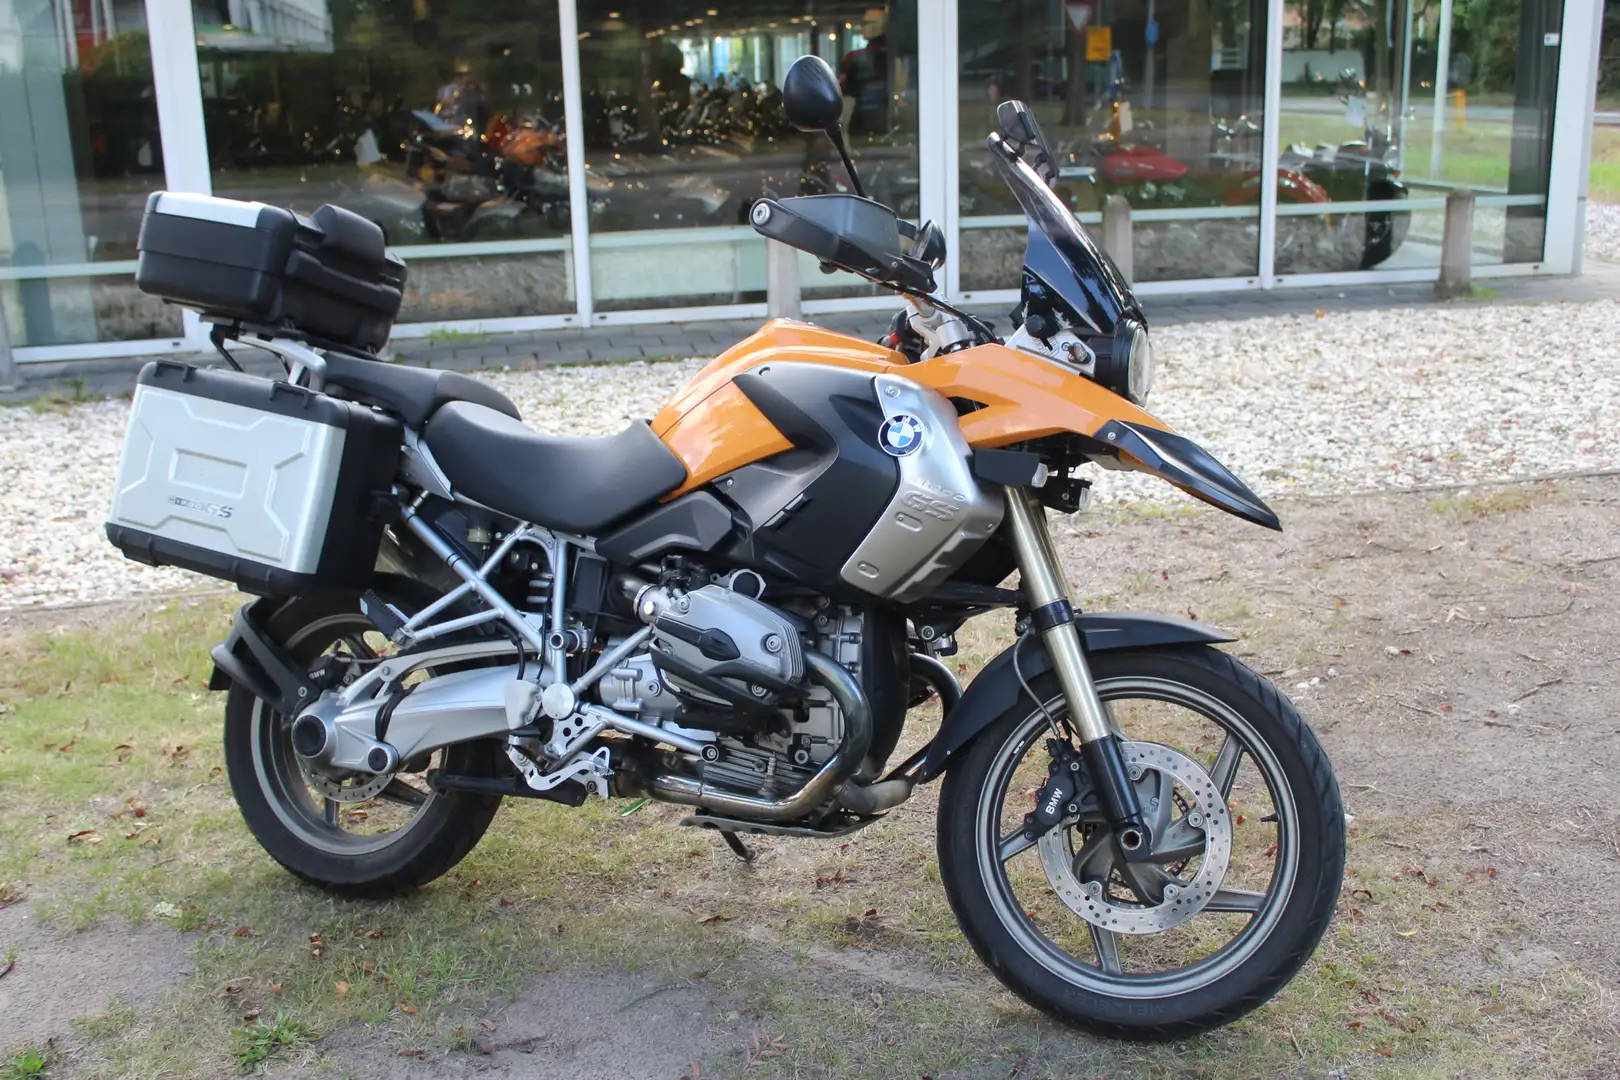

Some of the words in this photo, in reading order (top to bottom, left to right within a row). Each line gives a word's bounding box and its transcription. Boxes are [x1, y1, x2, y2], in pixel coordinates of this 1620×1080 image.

[901, 490, 959, 521] GS
[308, 668, 326, 679] BMW
[1045, 787, 1063, 815] BMW
[1061, 987, 1165, 1016] METZELER
